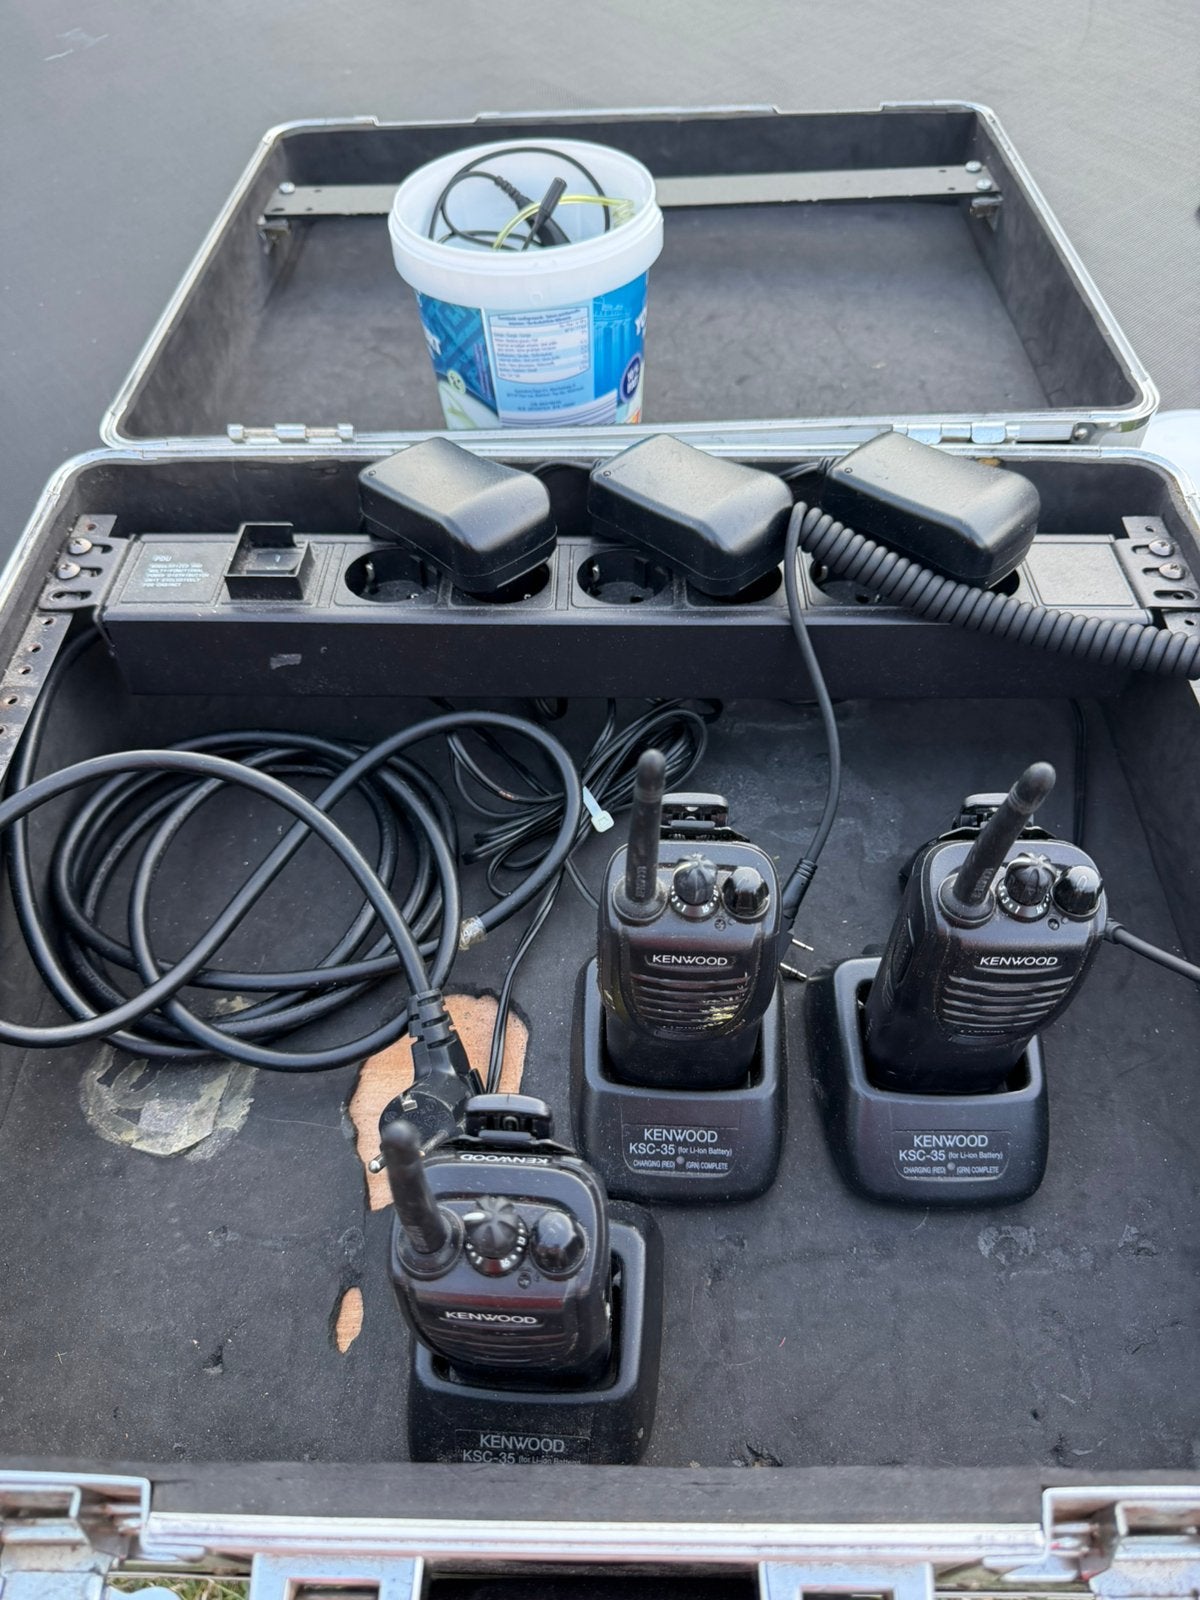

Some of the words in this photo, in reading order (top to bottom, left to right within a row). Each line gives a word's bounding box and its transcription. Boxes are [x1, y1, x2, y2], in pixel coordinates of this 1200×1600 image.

[652, 954, 728, 966] KENWOOD
[979, 956, 1059, 967] KENWOOD
[644, 1128, 718, 1143] KENWOOD
[913, 1134, 989, 1148] KENWOOD
[629, 1142, 676, 1156] KSC-35
[899, 1149, 946, 1162] KSC-35
[458, 1152, 549, 1164] KENWOOD
[700, 1162, 729, 1170] COMPLETE
[445, 1311, 538, 1325] KENWOOD
[479, 1433, 565, 1453] KENWOOD
[462, 1449, 516, 1465] KSC-35
